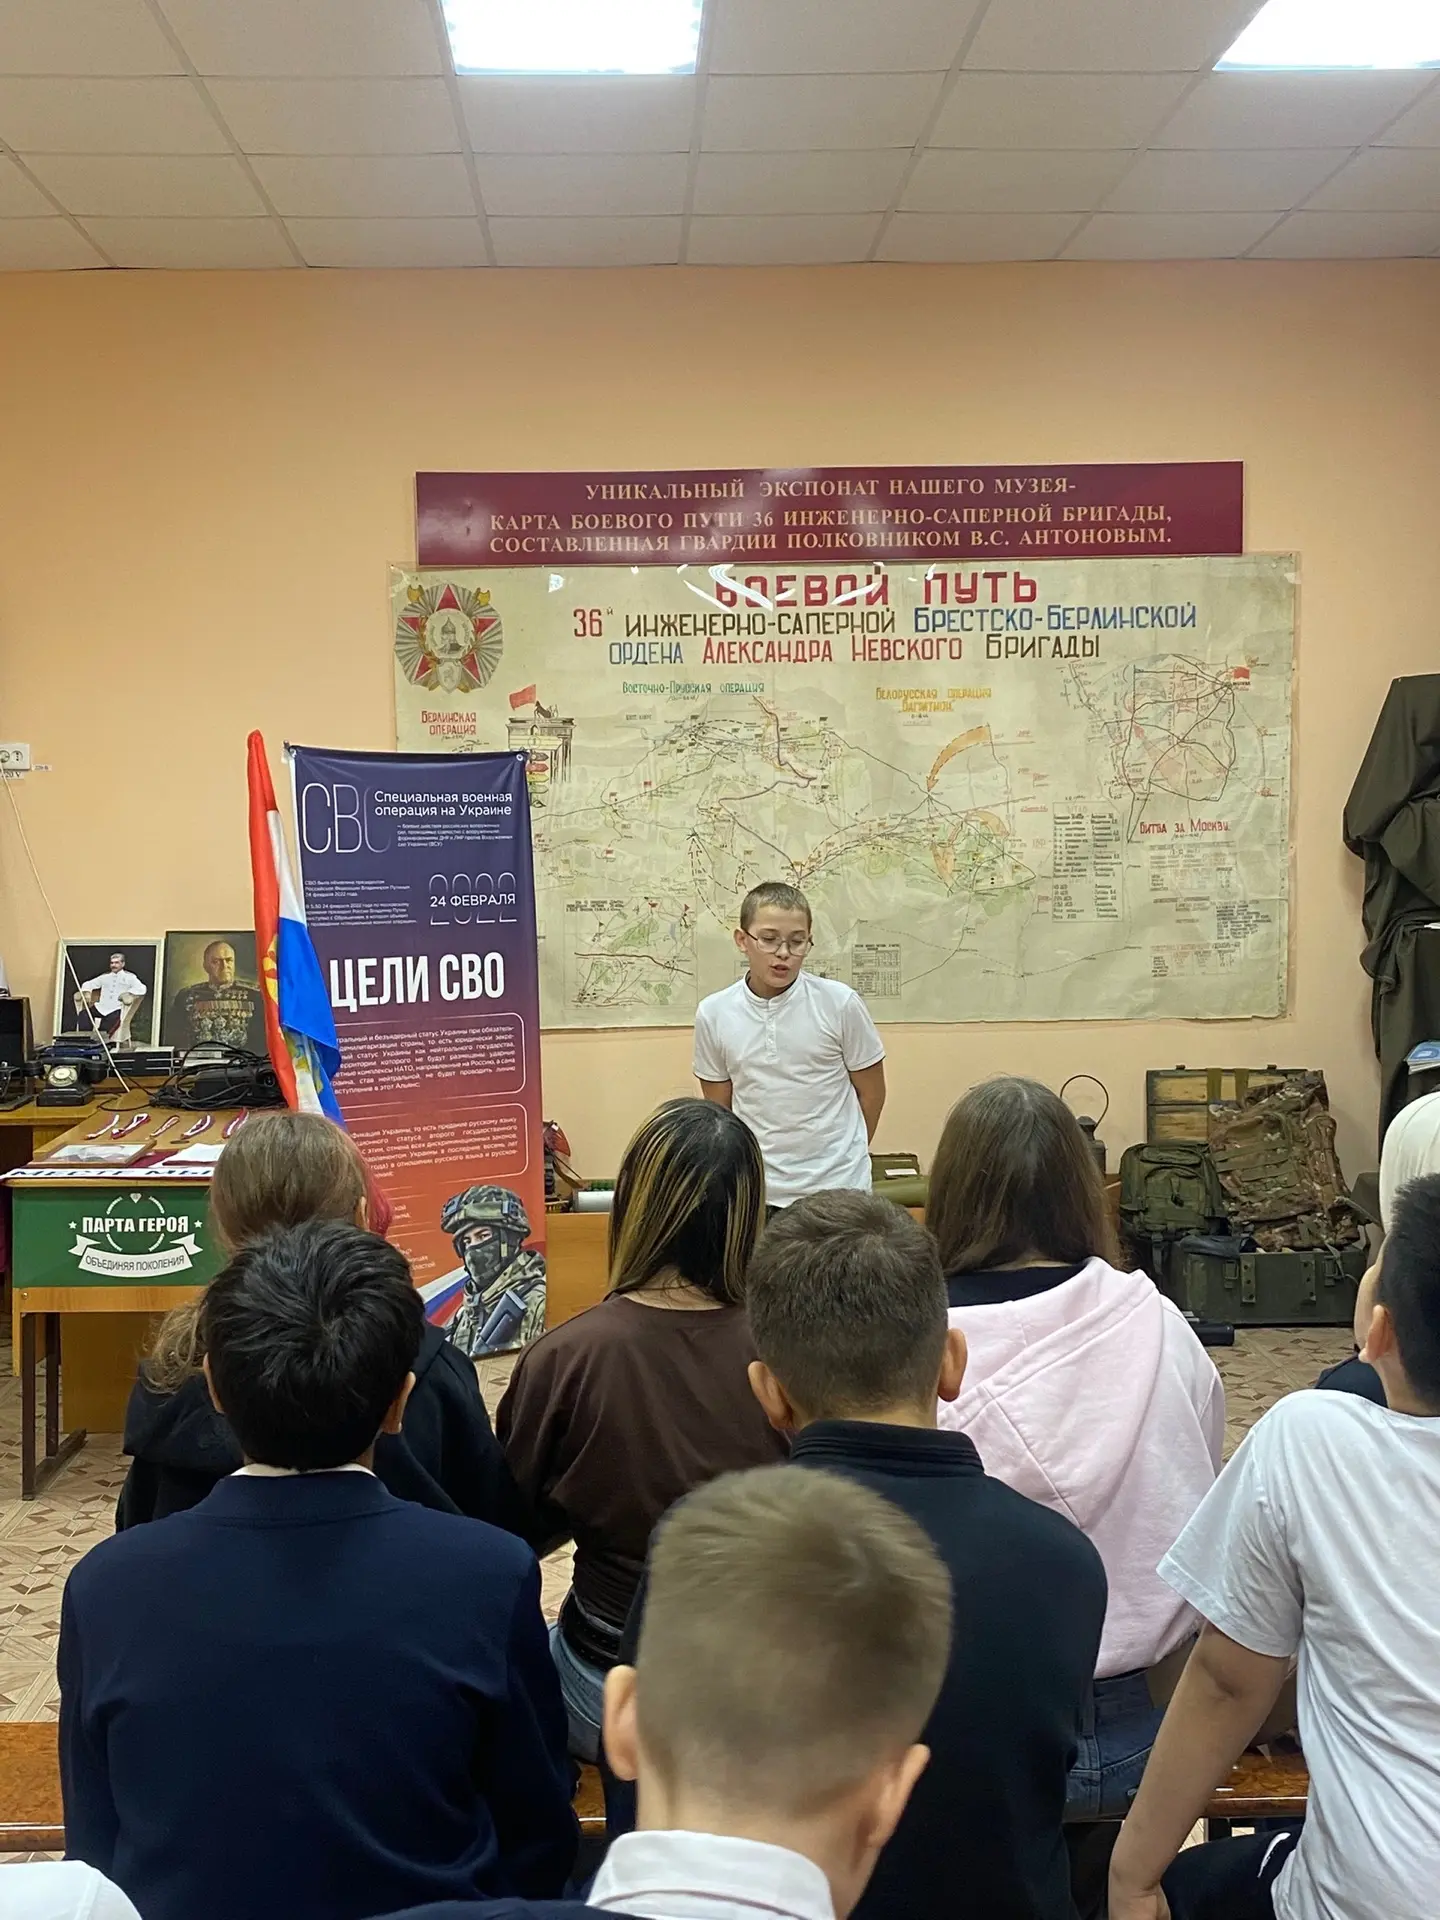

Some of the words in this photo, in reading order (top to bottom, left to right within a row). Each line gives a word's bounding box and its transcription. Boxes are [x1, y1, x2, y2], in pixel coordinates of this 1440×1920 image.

[586, 478, 744, 500] УНИКАЛЬНЫЙ
[759, 480, 880, 498] ЭКСПОНАТ
[889, 478, 985, 496] НАШЕГО
[994, 477, 1076, 494] МУЗЕЯ-
[490, 514, 561, 531] КАРТА
[570, 512, 674, 530] БОЕВОГО
[683, 512, 744, 528] ПУТИ
[752, 510, 774, 527] 36
[783, 504, 1053, 526] ИНЖЕНЕРНО-САПЕРНОЙ
[1062, 504, 1172, 524] БРИГАДЫ,
[490, 535, 670, 553] СОСТАВЛЕННАЯ
[680, 534, 776, 553] ГВАРДИИ
[787, 530, 960, 550] ПОЛКОВНИКОМ
[970, 529, 1010, 546] В.С.
[1020, 528, 1172, 546] АНТОНОВЫМ.
[715, 565, 890, 608] БОЕВОЙ
[924, 571, 1038, 605] ПУТЬ
[625, 608, 896, 638] ИНЖЕНЕРНО-САПЕРНОЙ
[609, 642, 684, 666] ОРДЕНА
[374, 791, 458, 804] Специальная
[462, 792, 512, 802] военная
[374, 806, 438, 818] операция
[440, 806, 456, 816] на
[460, 805, 512, 817] Украине
[430, 896, 446, 908] 24
[450, 894, 516, 906] ФЕВРАЛЯ
[329, 955, 430, 1013] ЦЕЛИ
[439, 952, 505, 1001] СВО
[82, 1216, 136, 1233] ПАРТА
[138, 1216, 188, 1233] ГЕРОЯ
[85, 1254, 134, 1271] ОБЪЕДИНЯЯ
[136, 1254, 185, 1271] ПОКОЛЕНИЯ
